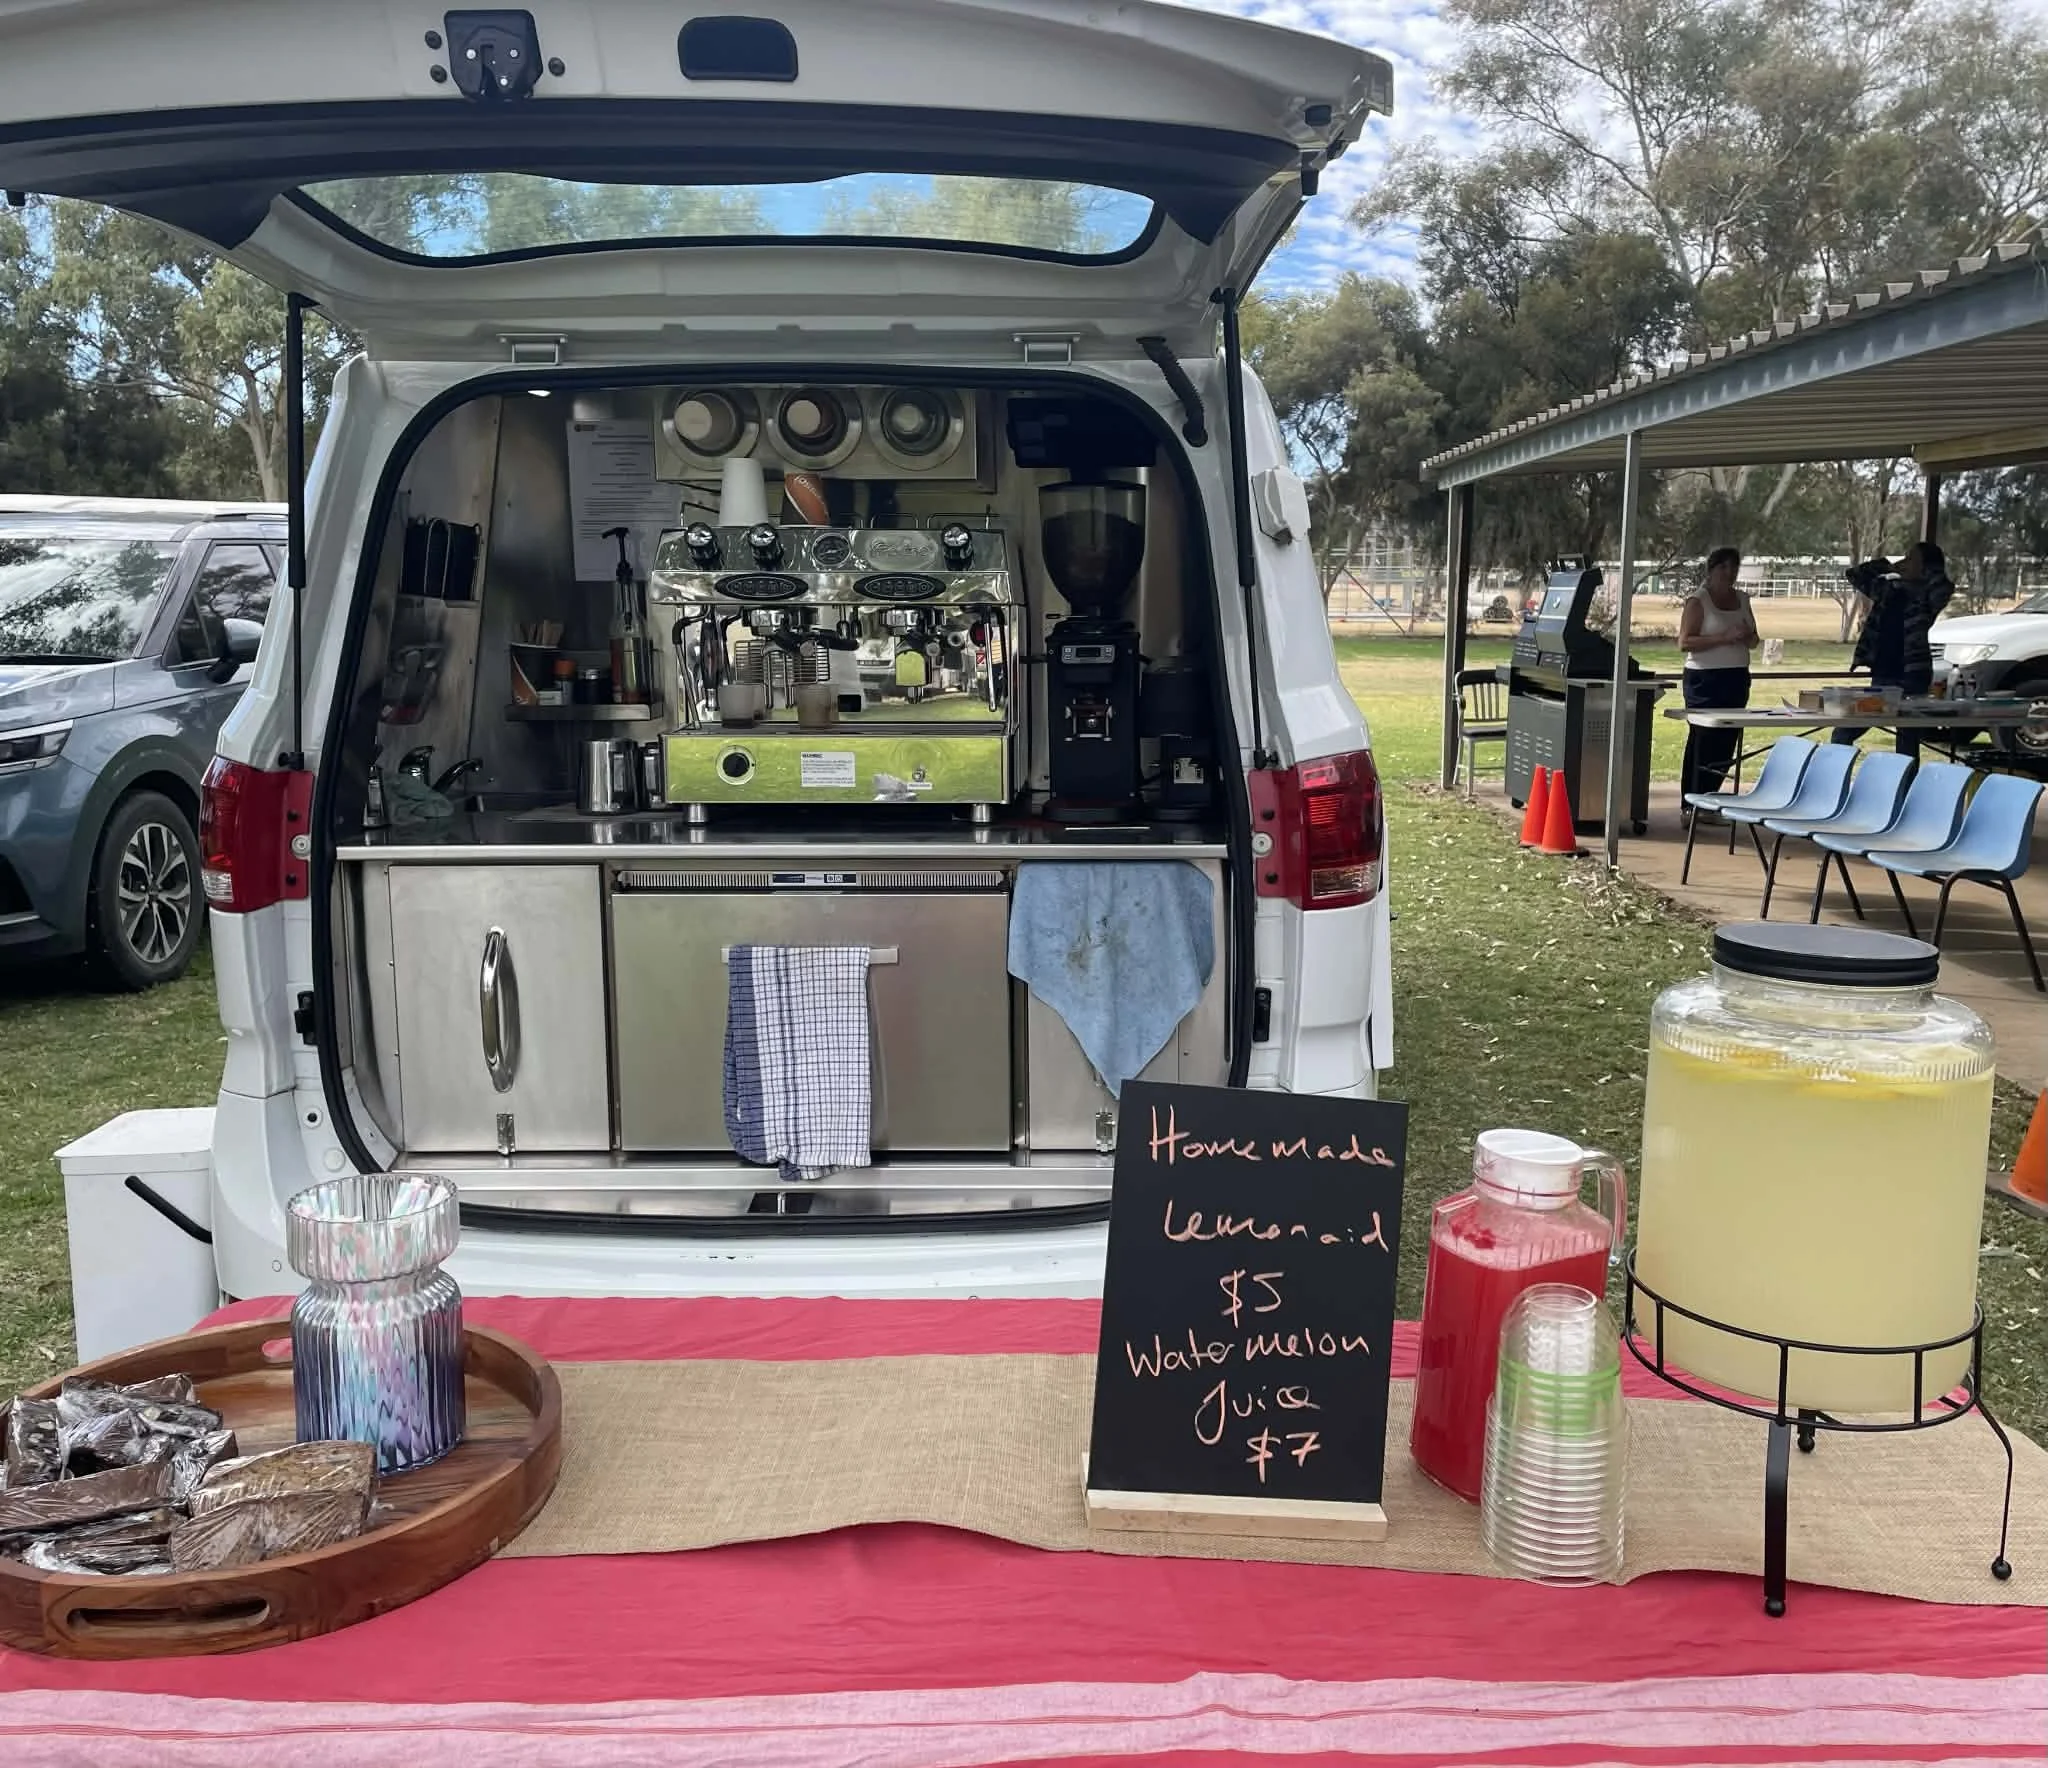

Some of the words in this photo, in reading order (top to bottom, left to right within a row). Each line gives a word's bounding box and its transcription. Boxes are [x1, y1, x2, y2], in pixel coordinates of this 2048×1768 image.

[1219, 1269, 1284, 1328] $5
[1193, 1379, 1321, 1446] Juice
[1245, 1426, 1321, 1484] $7
